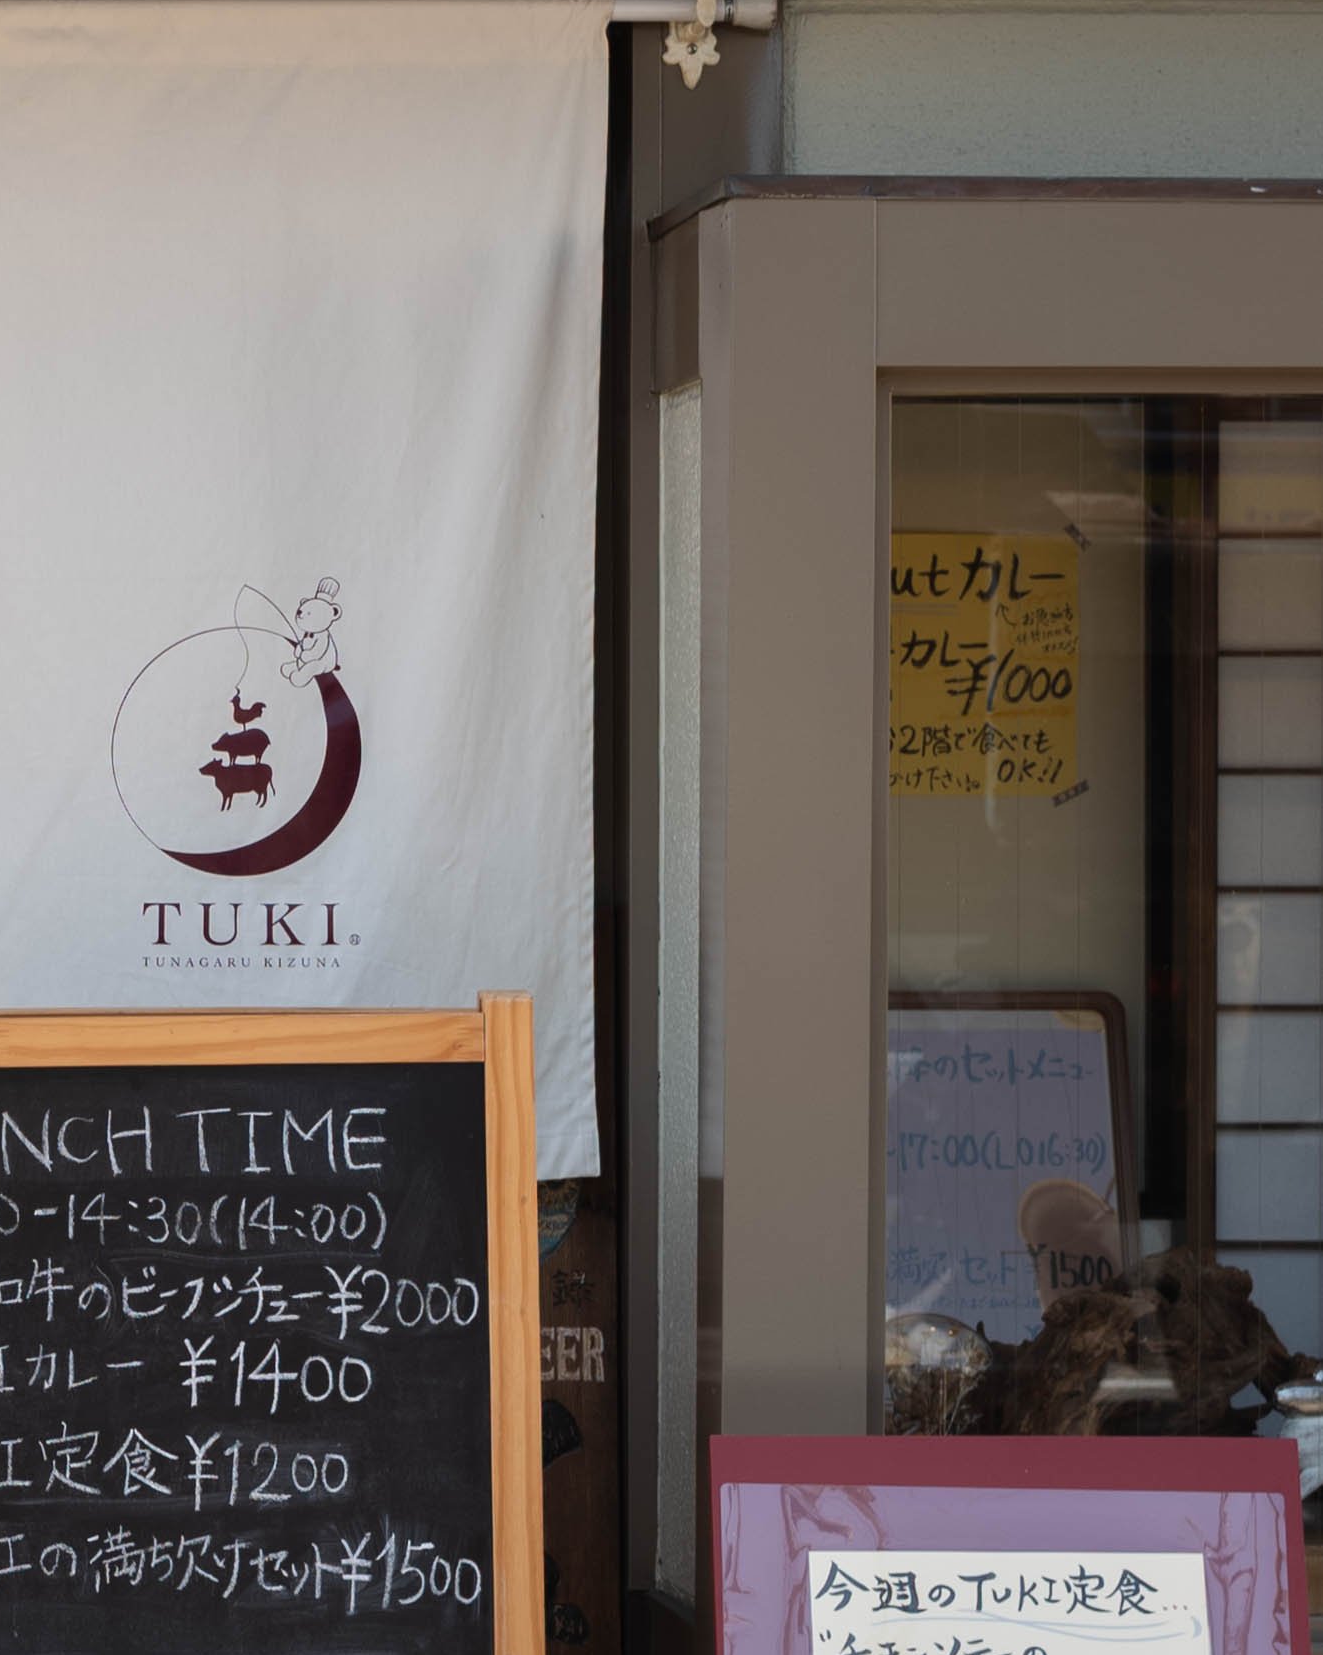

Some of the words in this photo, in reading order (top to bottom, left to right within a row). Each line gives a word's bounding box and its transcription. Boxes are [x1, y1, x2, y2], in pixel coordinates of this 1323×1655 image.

[890, 630, 989, 669] カレー
[945, 648, 1072, 716] ¥1000
[141, 902, 341, 946] TUKI
[141, 955, 252, 968] TUNAGARU
[262, 955, 341, 968] KIZUNA
[176, 1107, 387, 1175] TIME
[181, 1336, 373, 1415] ¥1400
